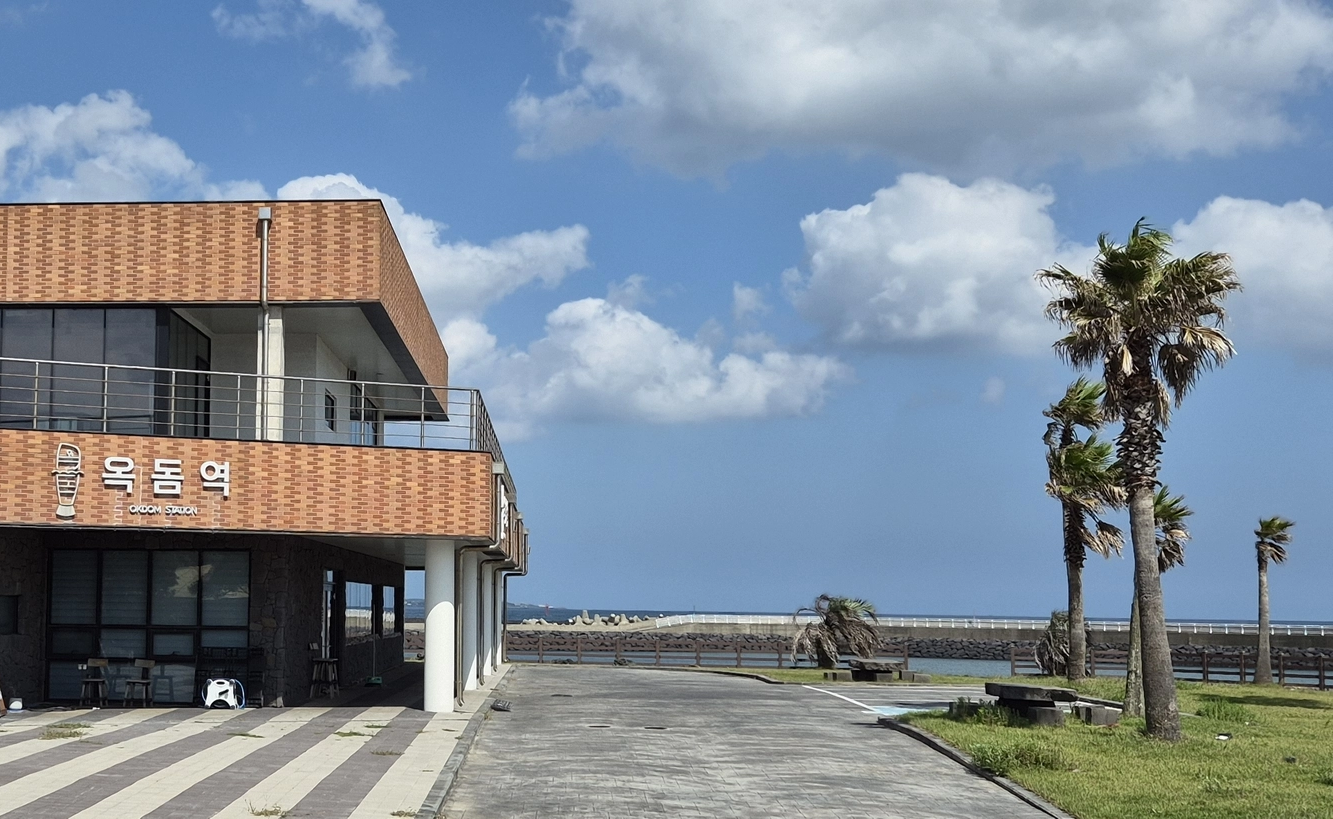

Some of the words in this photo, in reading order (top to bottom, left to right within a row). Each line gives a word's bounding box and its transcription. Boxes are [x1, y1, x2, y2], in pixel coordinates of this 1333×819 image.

[102, 456, 230, 498] 옥돔역
[129, 505, 162, 515] OKDOM
[165, 505, 198, 516] STATION
